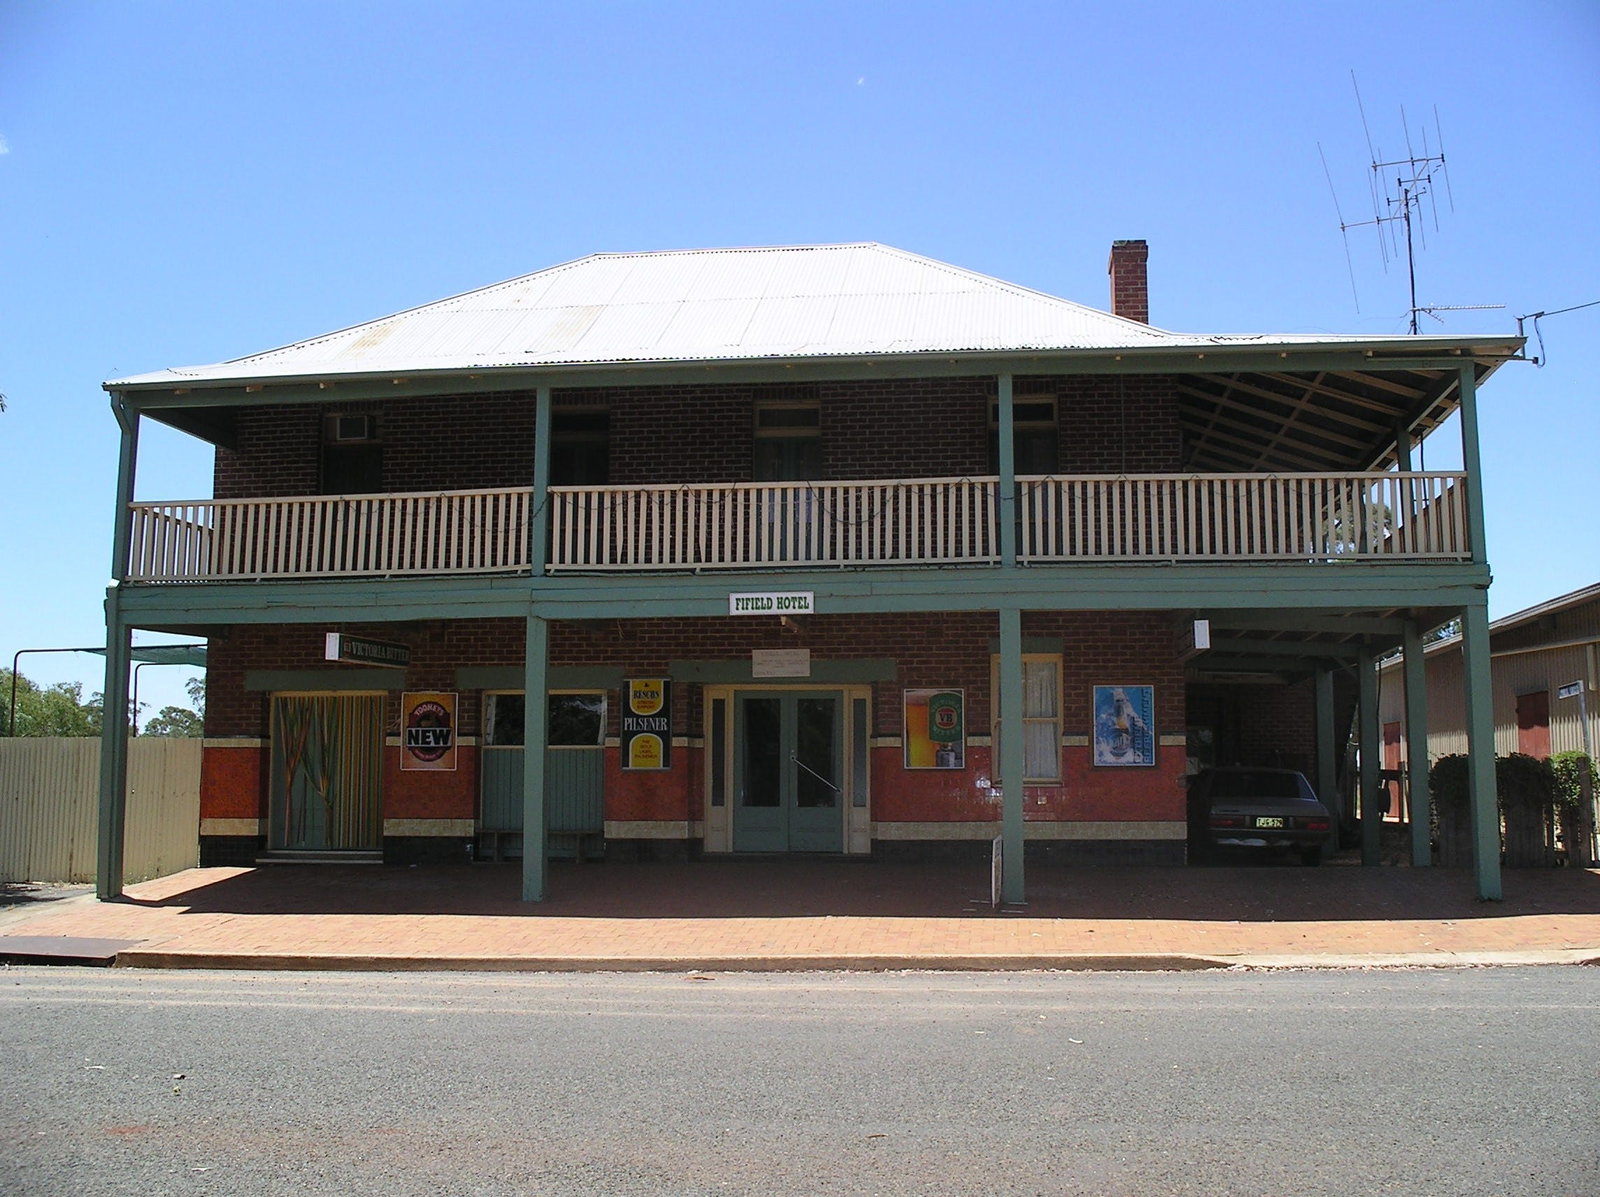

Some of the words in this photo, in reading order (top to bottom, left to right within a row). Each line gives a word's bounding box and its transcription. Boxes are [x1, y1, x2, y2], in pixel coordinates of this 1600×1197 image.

[735, 597, 773, 611] FIFIELD
[776, 596, 810, 610] HOTEL
[352, 641, 386, 659] VICTORIA
[386, 646, 410, 662] BITTER
[624, 717, 668, 731] PILSENER
[939, 713, 953, 723] VB
[407, 729, 452, 745] NEW
